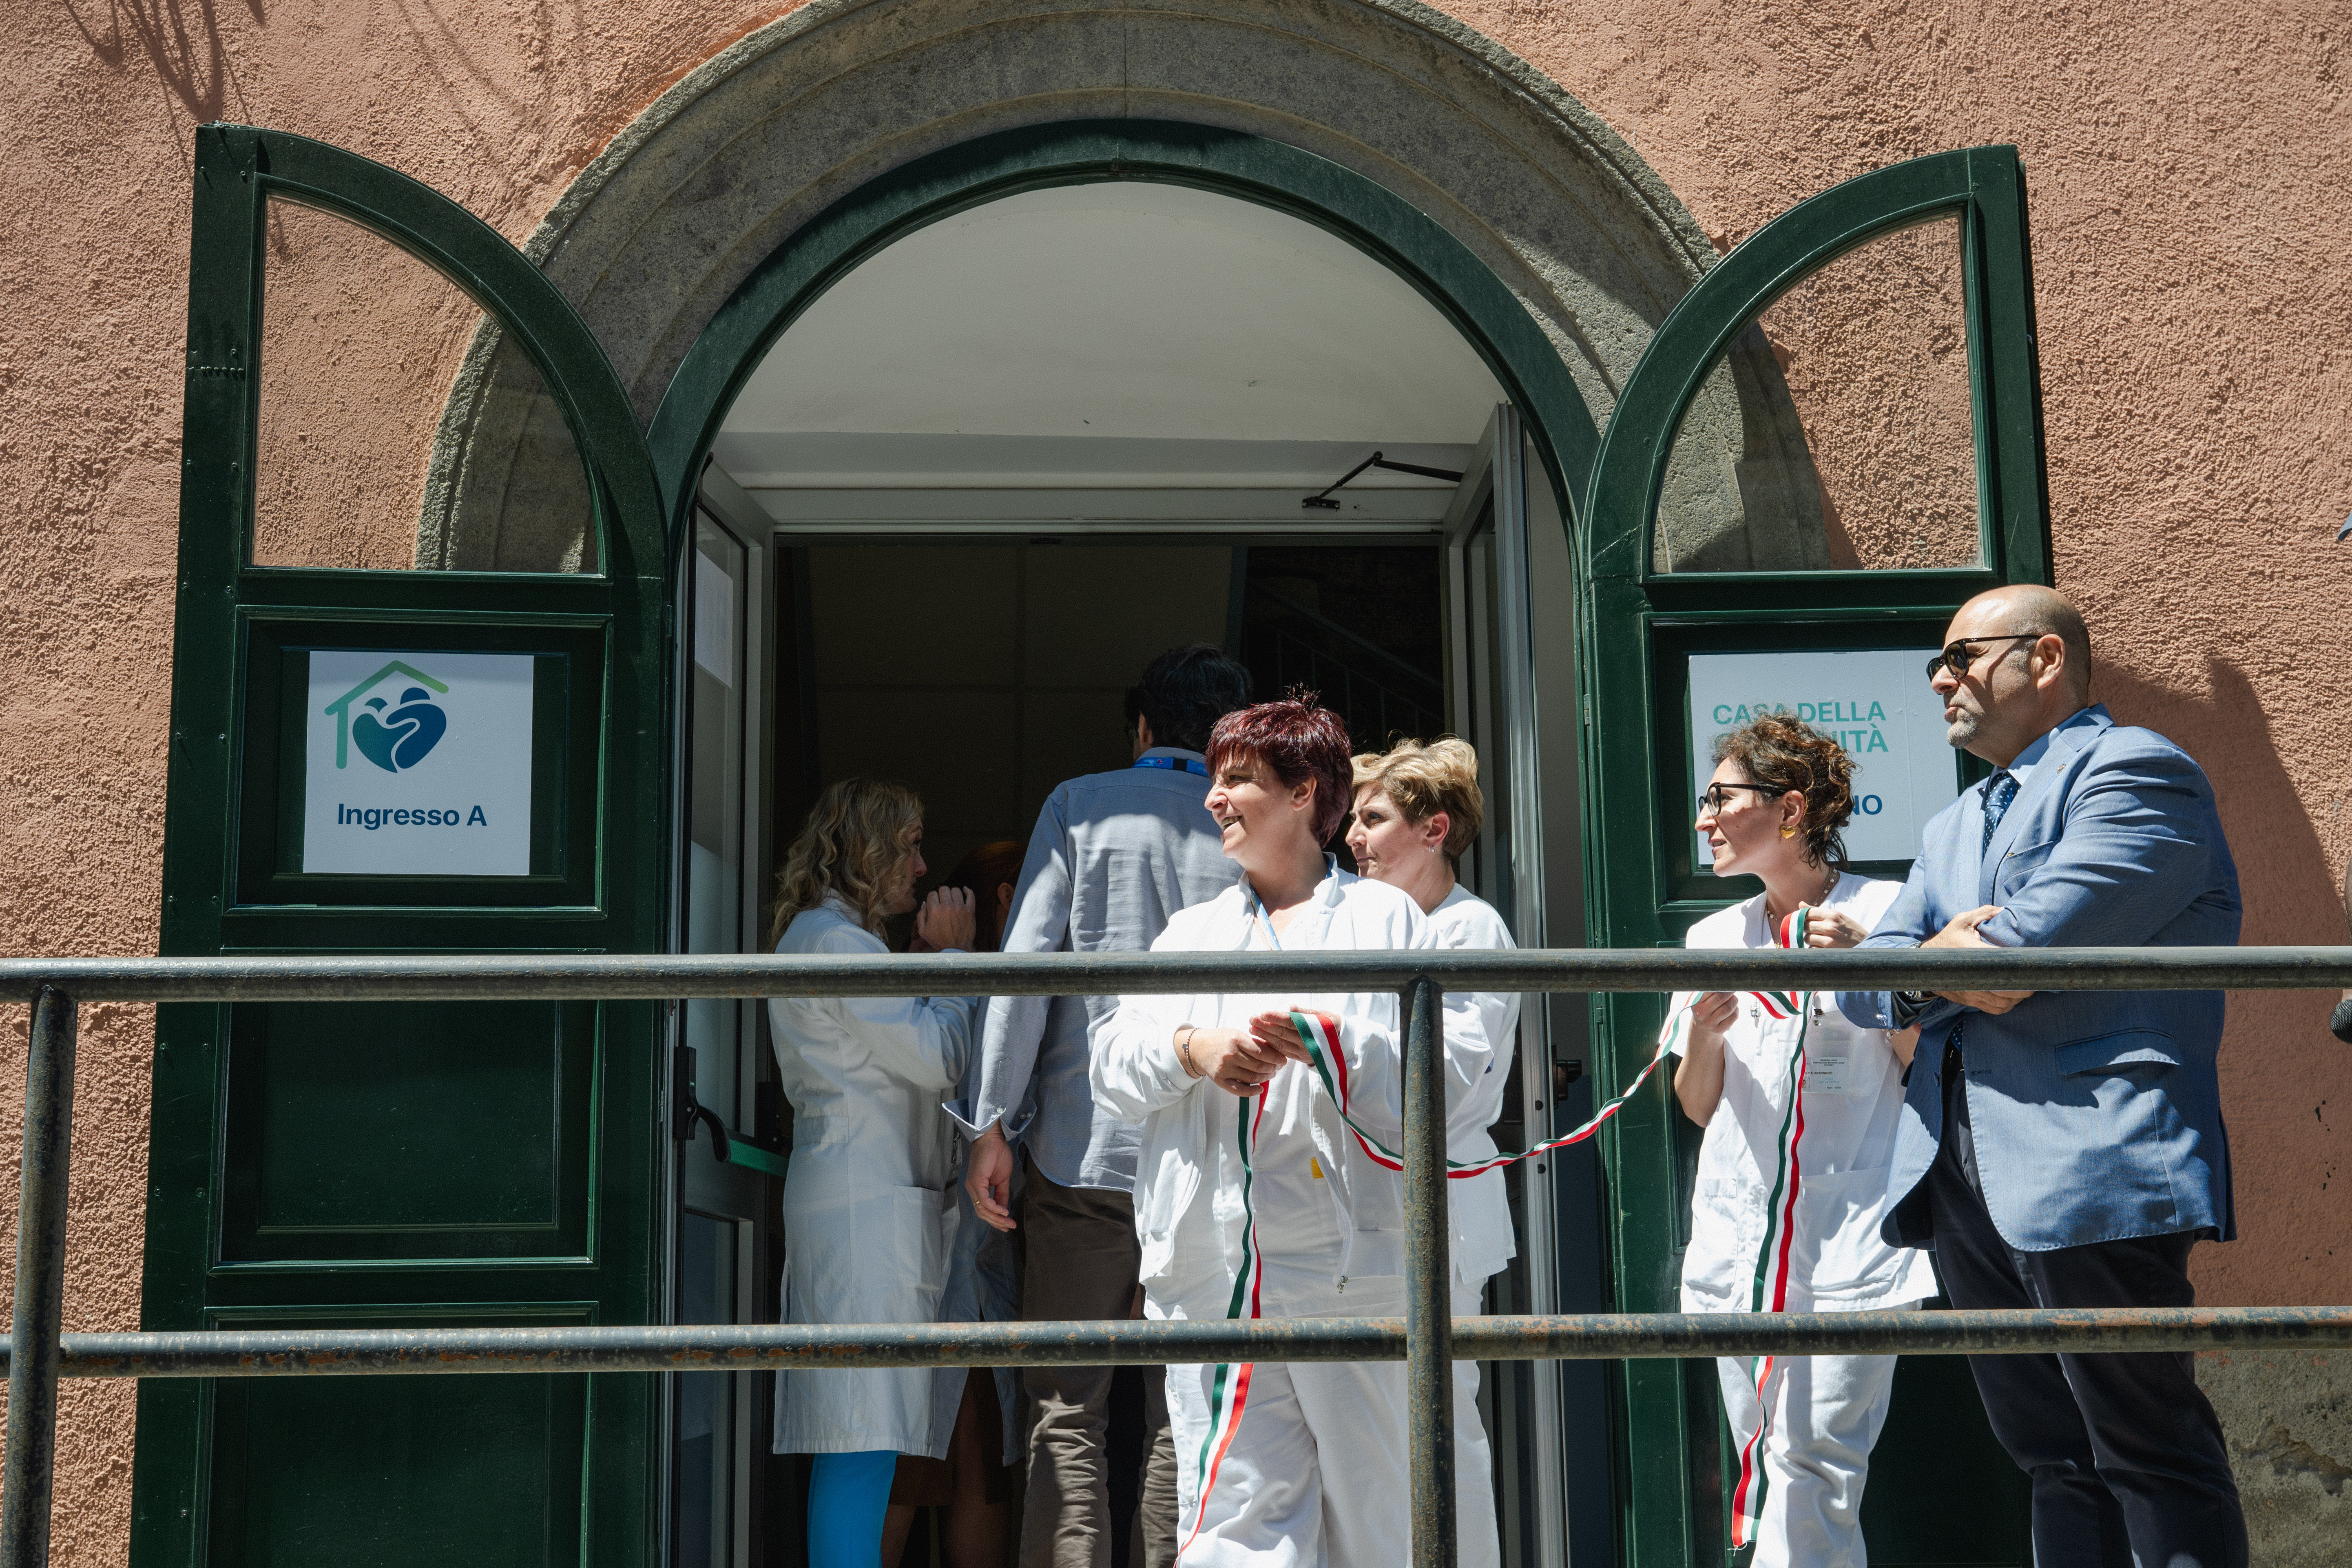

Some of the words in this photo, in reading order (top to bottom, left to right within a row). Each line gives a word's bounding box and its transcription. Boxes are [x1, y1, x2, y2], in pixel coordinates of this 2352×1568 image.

[1798, 701, 1886, 723] DELLA
[338, 803, 460, 830] Ingresso
[467, 805, 487, 826] A
